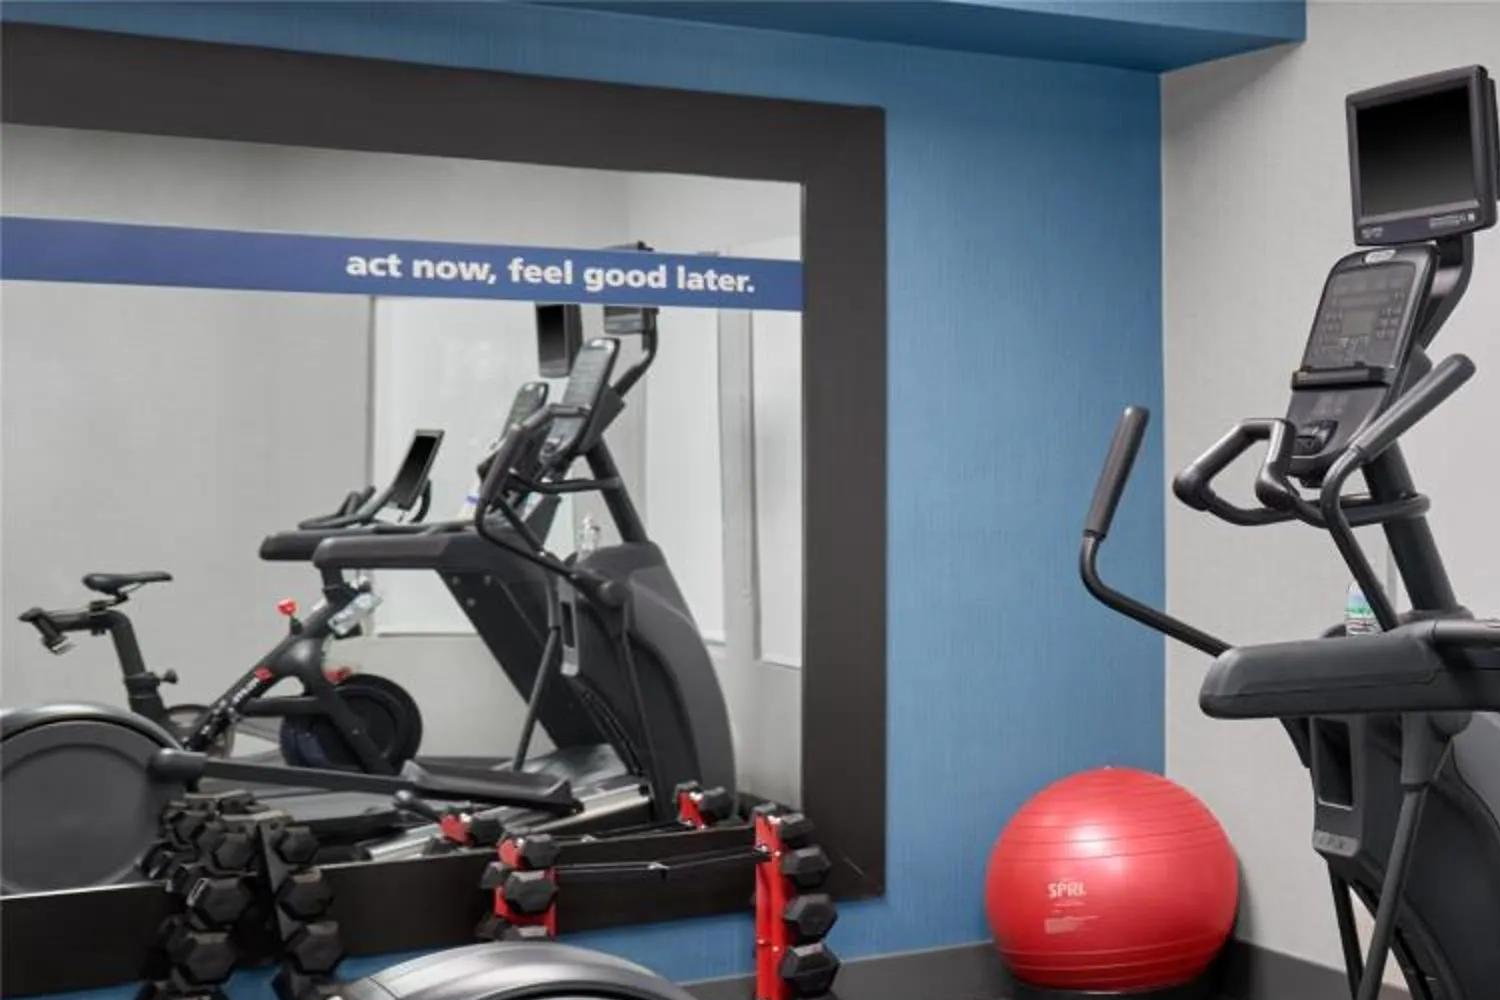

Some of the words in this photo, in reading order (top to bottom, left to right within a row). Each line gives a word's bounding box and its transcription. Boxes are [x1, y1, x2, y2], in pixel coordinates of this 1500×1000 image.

[346, 253, 402, 278] act
[412, 258, 496, 285] now,
[508, 256, 574, 285] feel
[583, 264, 668, 292] good
[677, 264, 756, 293] later.
